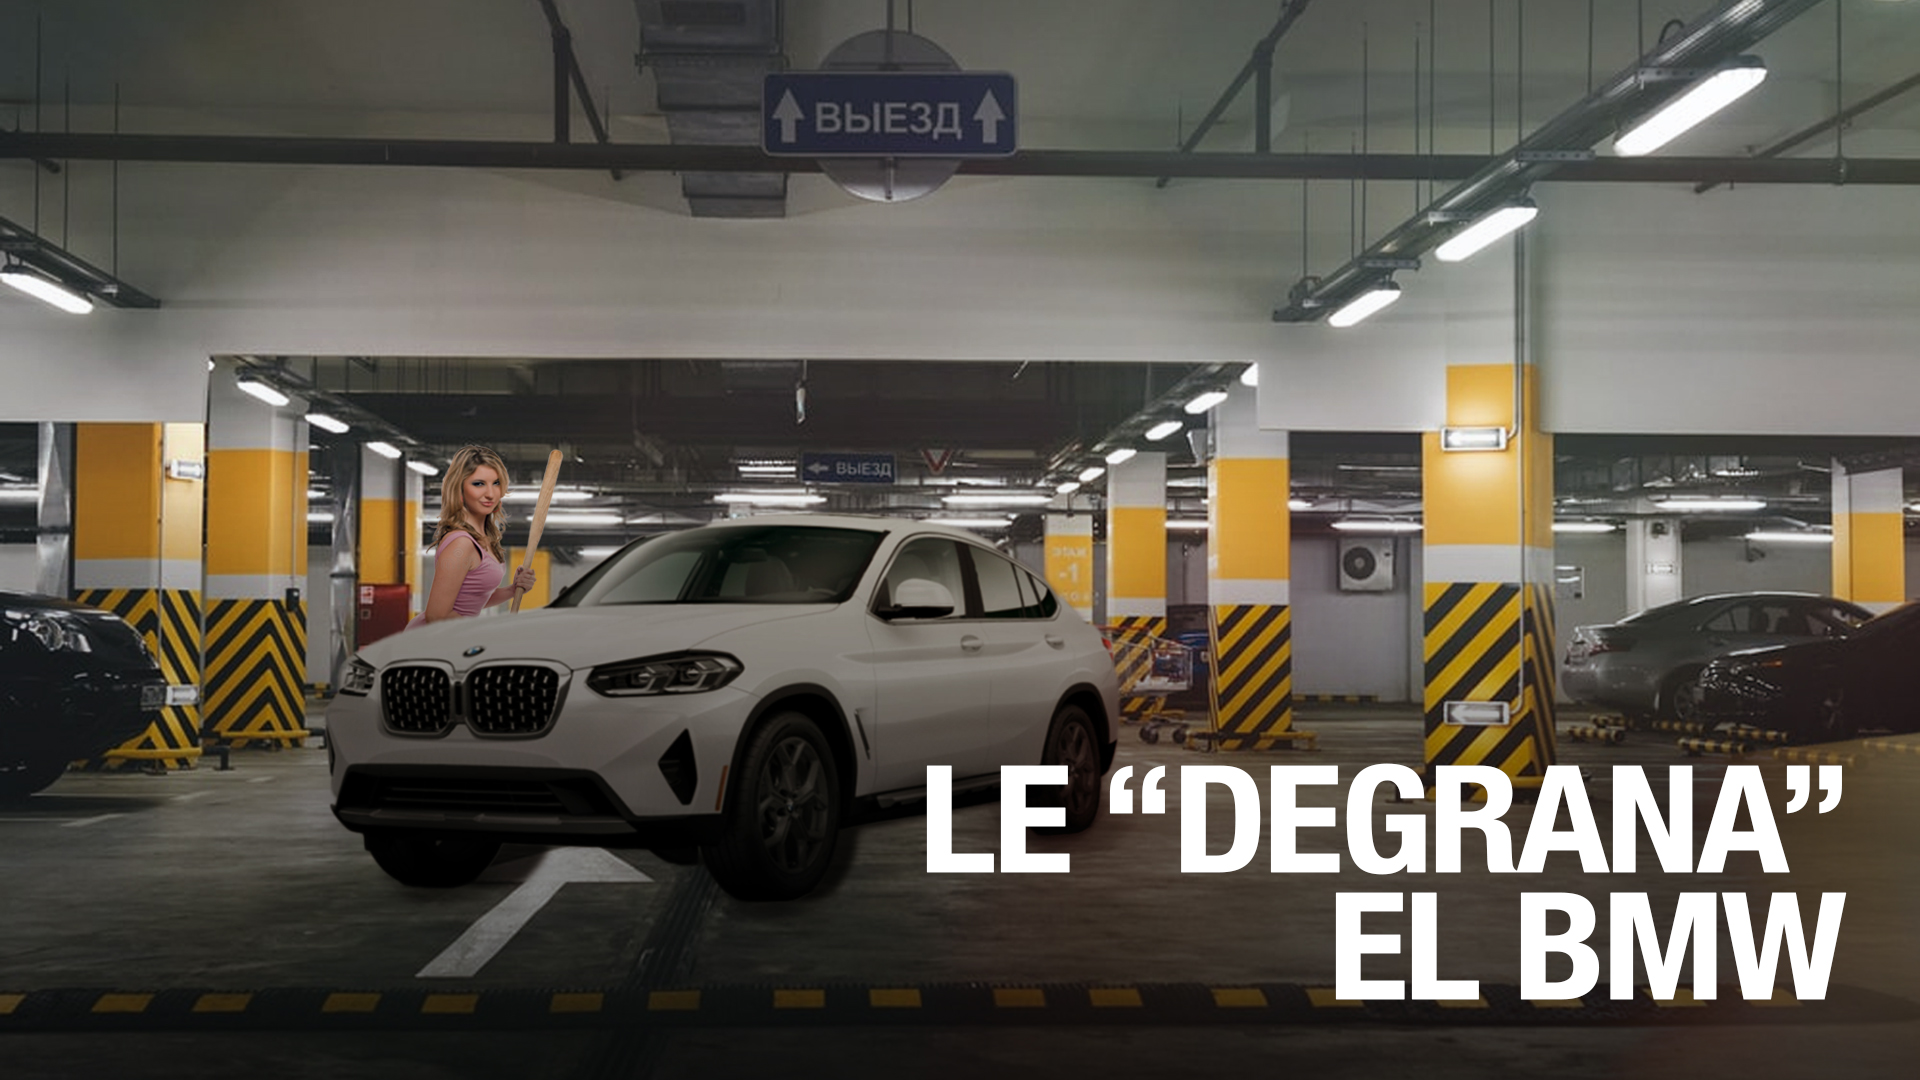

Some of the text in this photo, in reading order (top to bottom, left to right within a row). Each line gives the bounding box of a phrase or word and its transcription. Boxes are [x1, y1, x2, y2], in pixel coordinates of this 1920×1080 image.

[816, 103, 962, 140] ВЫЕЗД
[836, 462, 892, 477] ВЫЕЗД
[1059, 562, 1078, 583] -1
